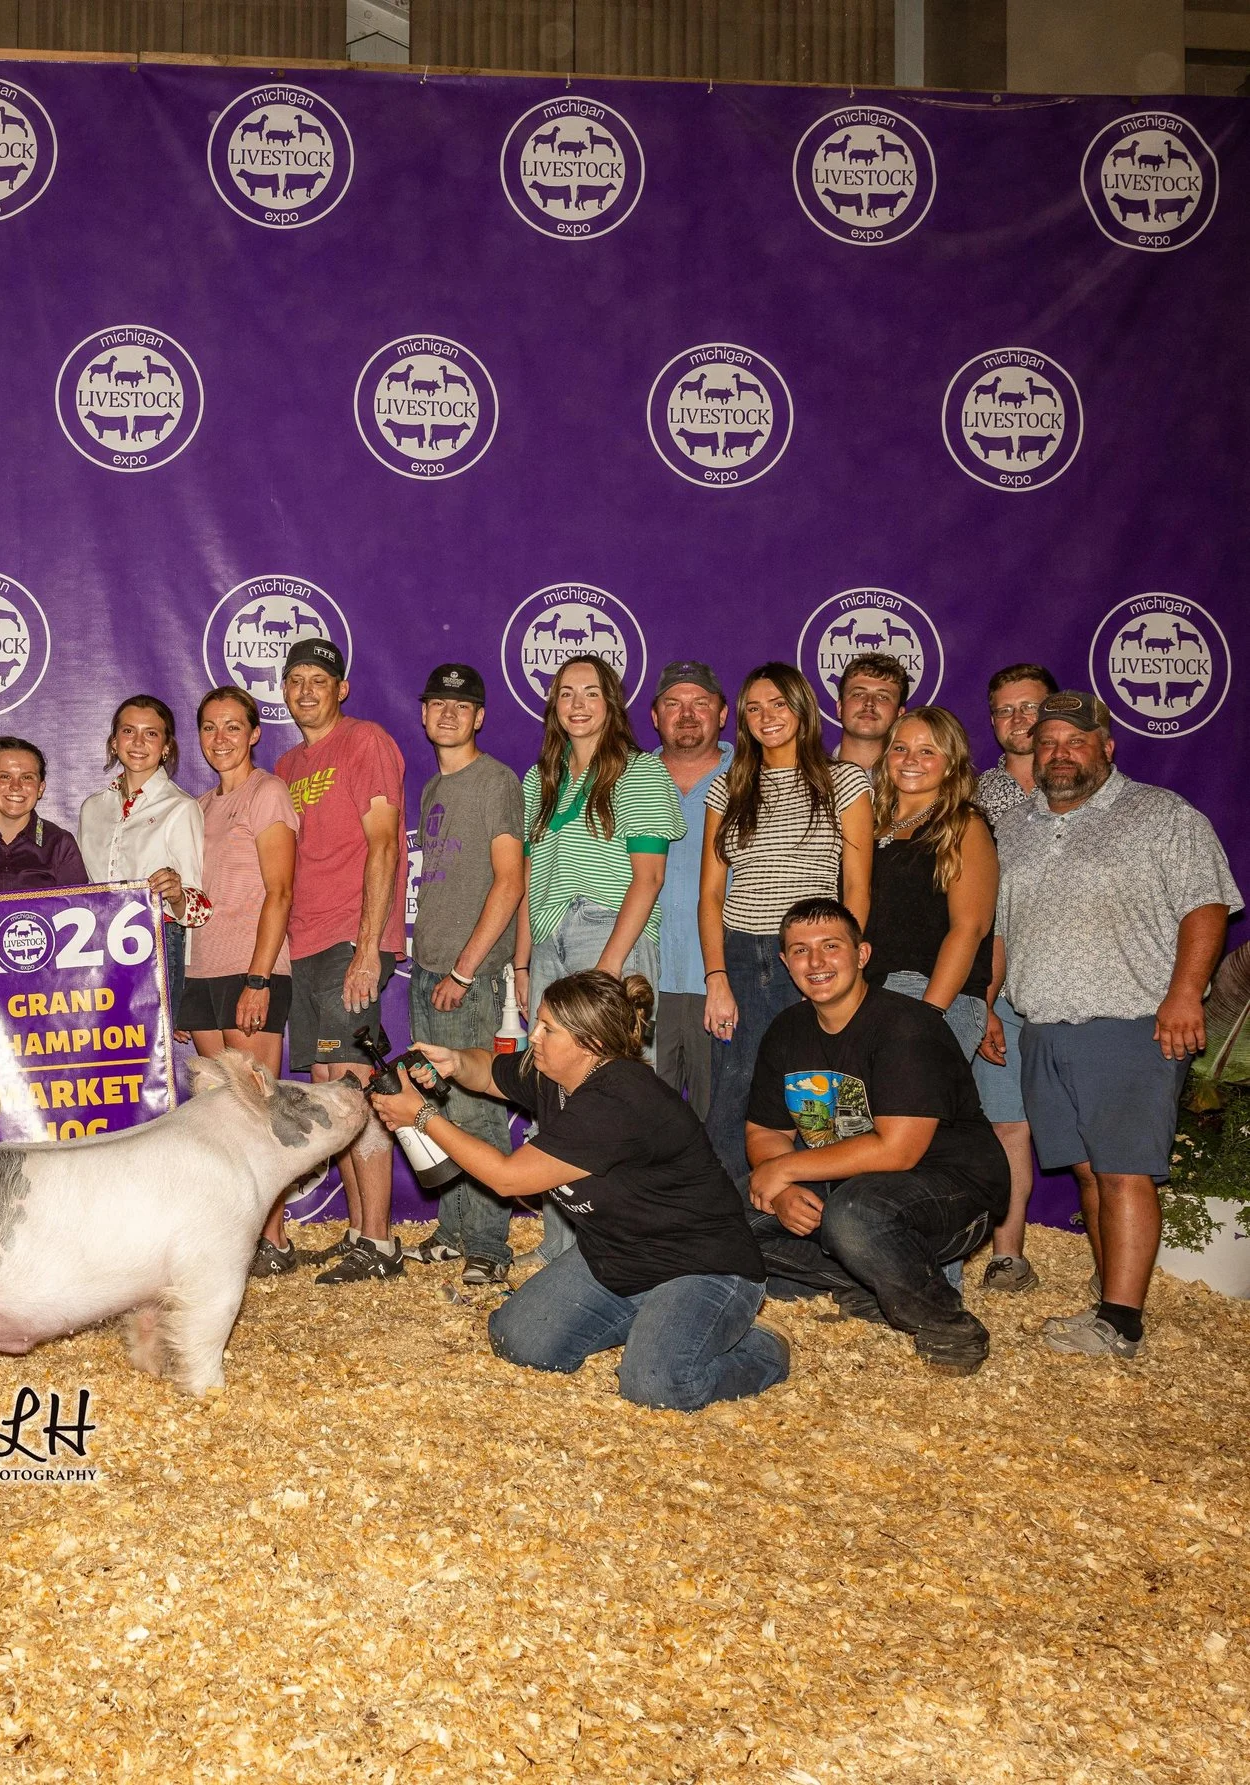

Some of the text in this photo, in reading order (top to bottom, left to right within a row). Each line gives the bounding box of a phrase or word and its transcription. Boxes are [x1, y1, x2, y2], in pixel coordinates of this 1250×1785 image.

[252, 88, 313, 108] michigan
[544, 100, 604, 119] michigan
[834, 110, 896, 127] michigan
[1121, 115, 1182, 133] michigan
[231, 149, 331, 167] LIVESTOCK
[523, 161, 622, 178] LIVESTOCK
[815, 169, 914, 185] LIVESTOCK
[1102, 174, 1199, 191] LIVESTOCK
[265, 212, 298, 225] expo
[557, 224, 590, 236] expo
[851, 229, 882, 242] expo
[1138, 235, 1170, 247] expo
[100, 329, 163, 348] michigan
[397, 339, 458, 358] michigan
[690, 347, 752, 365] michigan
[983, 352, 1044, 369] michigan
[79, 391, 180, 408] LIVESTOCK
[377, 398, 476, 417] LIVESTOCK
[670, 408, 770, 424] LIVESTOCK
[965, 412, 1062, 429] LIVESTOCK
[113, 455, 147, 468] expo
[411, 463, 444, 475] expo
[704, 471, 738, 483] expo
[1000, 474, 1031, 487] expo
[248, 579, 311, 598] michigan
[544, 587, 605, 606] michigan
[840, 592, 902, 610] michigan
[1130, 597, 1191, 615] michigan
[227, 641, 291, 658] LIVEST
[1112, 658, 1208, 674] LIVESTOCK
[261, 705, 291, 719] exp
[1146, 720, 1179, 734] expo
[10, 913, 37, 922] michigan
[4, 938, 46, 948] LIVESTOCK
[7, 987, 115, 1018] GRAND
[7, 1024, 146, 1057] HAMPION
